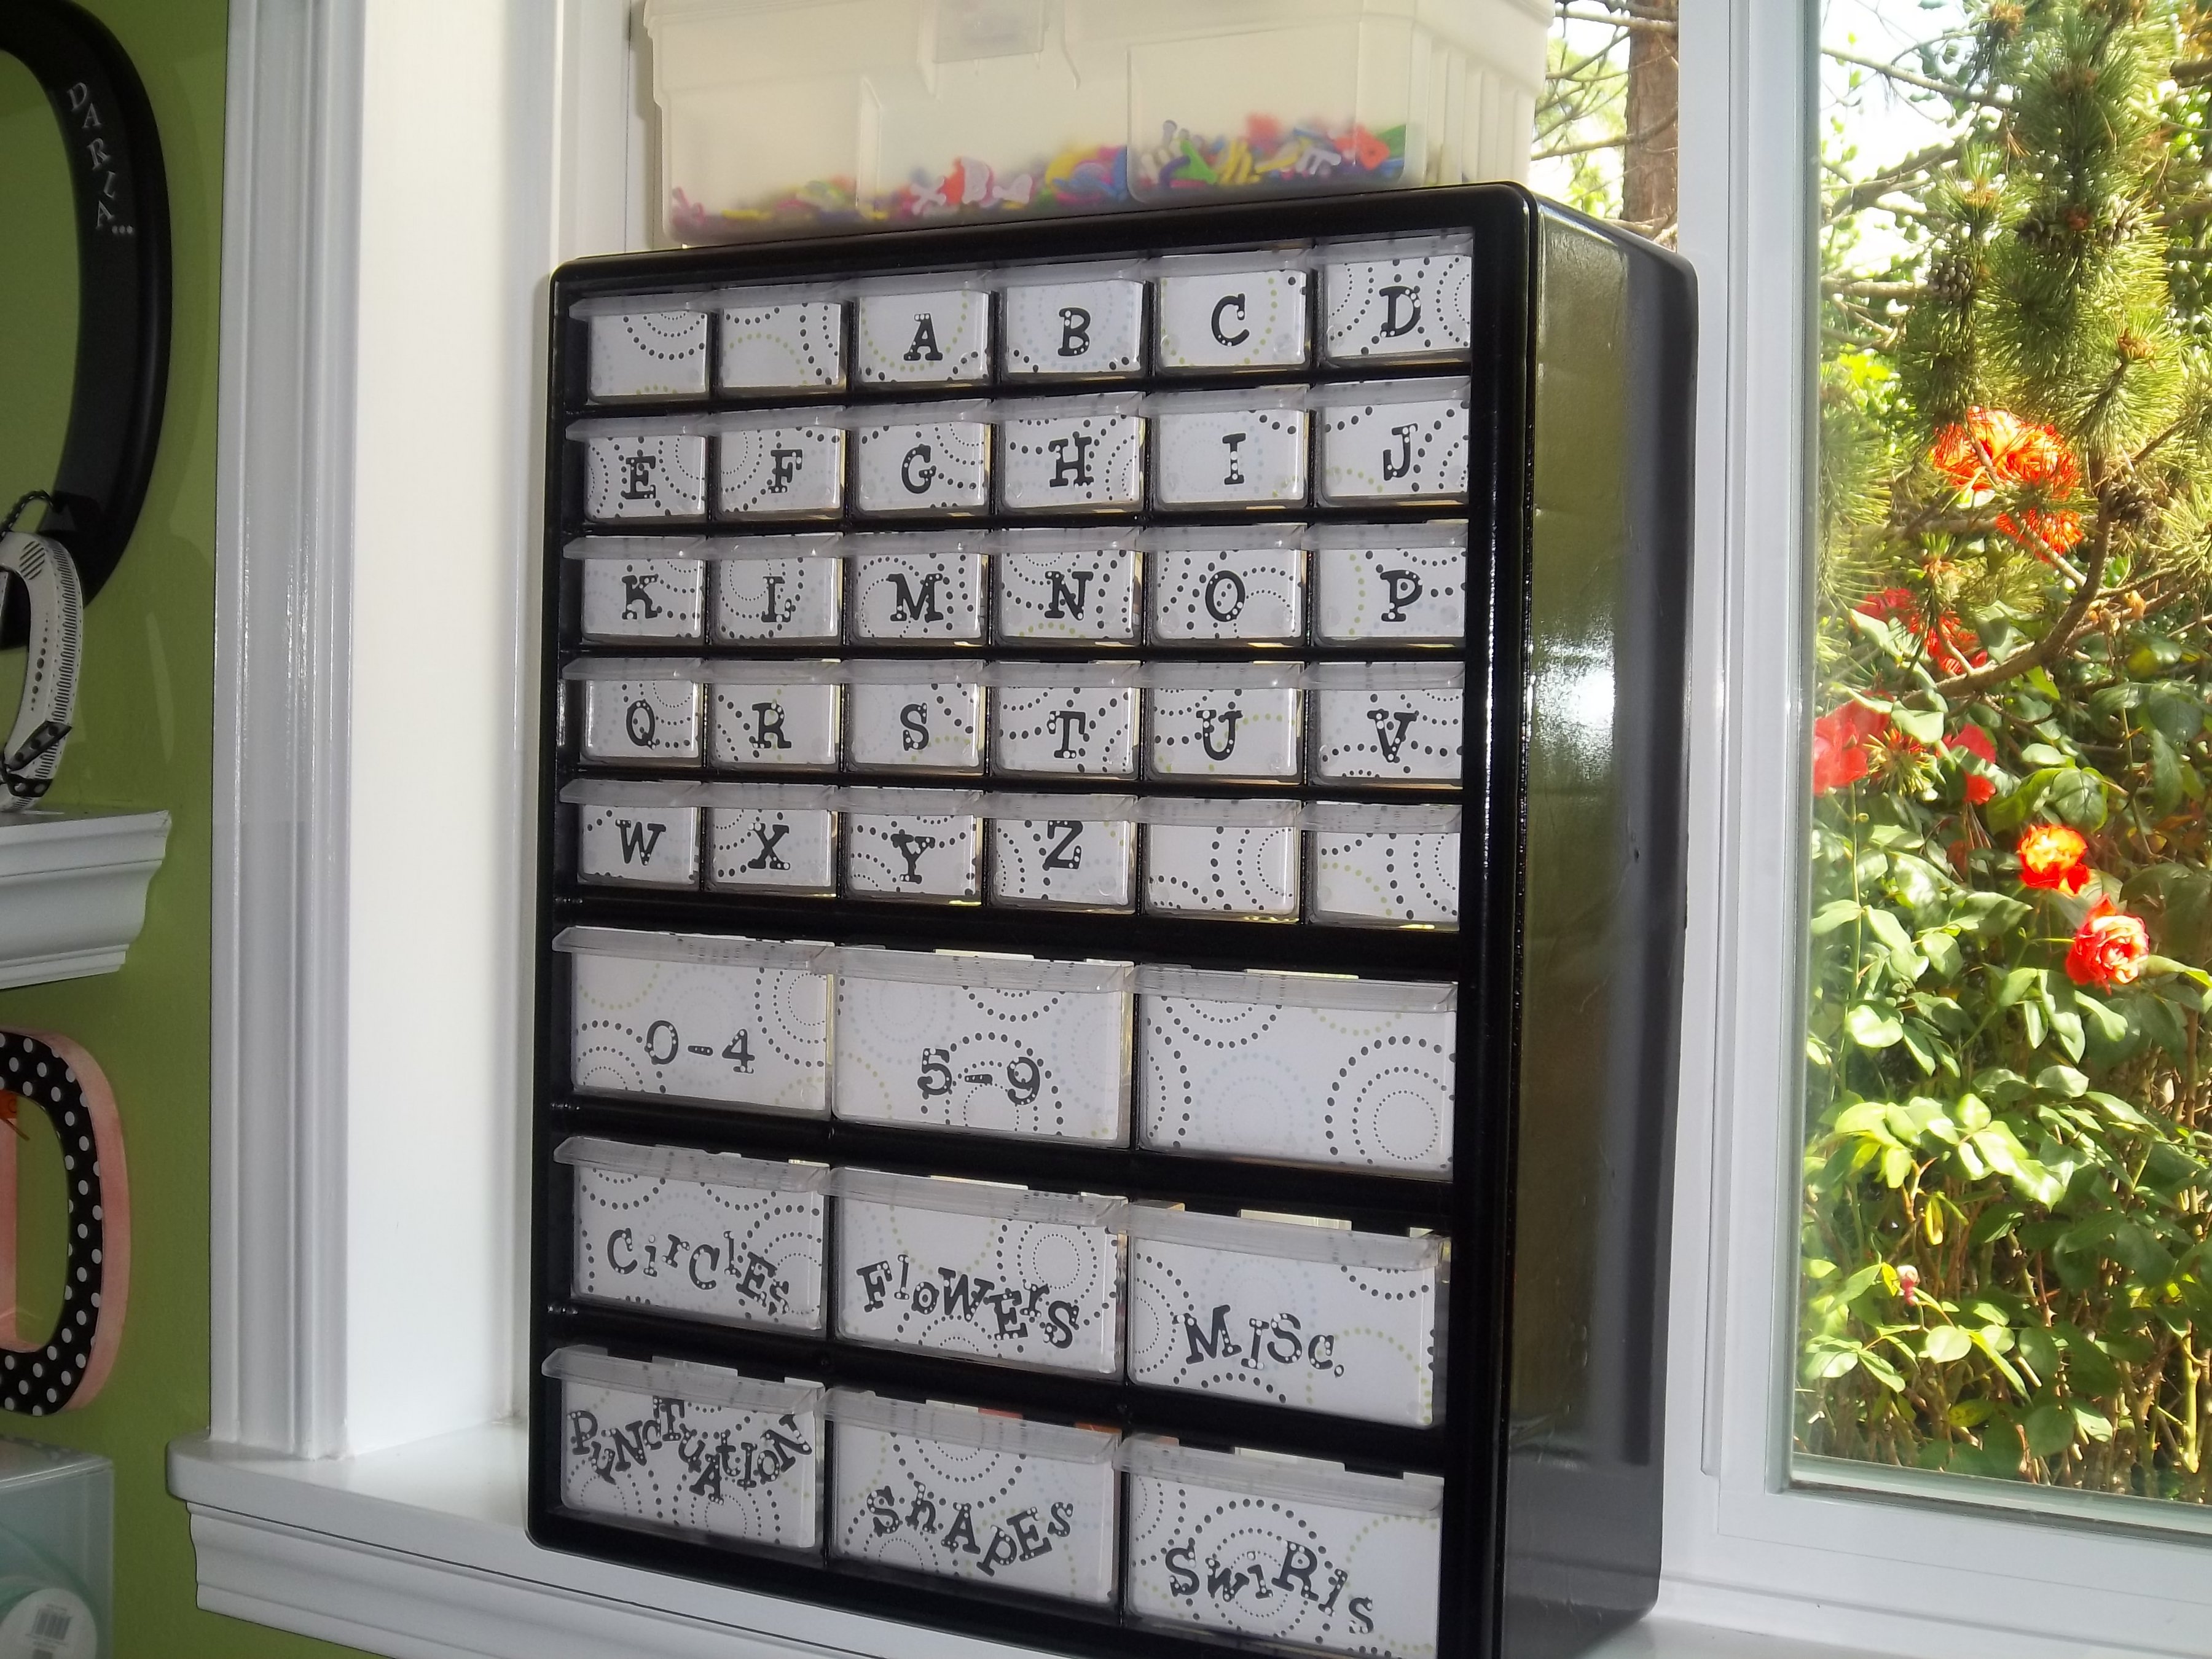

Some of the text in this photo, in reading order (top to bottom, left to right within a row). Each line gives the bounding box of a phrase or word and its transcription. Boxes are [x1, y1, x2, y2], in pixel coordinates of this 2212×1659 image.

[903, 313, 943, 361] A
[1057, 307, 1091, 356] B
[1211, 293, 1250, 347] C
[1379, 286, 1422, 339] D
[769, 449, 803, 493] F
[901, 444, 936, 494] G
[1048, 433, 1094, 488] H
[1222, 433, 1247, 485] I
[1383, 423, 1418, 480] J
[621, 455, 656, 500] E
[621, 574, 659, 620] K
[761, 576, 792, 623] L
[885, 573, 944, 623] M
[1045, 571, 1094, 621] N
[1379, 570, 1424, 622] P
[625, 699, 657, 750] Q
[751, 702, 792, 750] R
[900, 702, 930, 751] S
[1047, 710, 1086, 759] T
[1195, 708, 1244, 761] U
[1367, 709, 1418, 763] V
[614, 818, 667, 866] W
[747, 822, 790, 869] X
[890, 831, 936, 884] Y
[1043, 820, 1083, 870] Z
